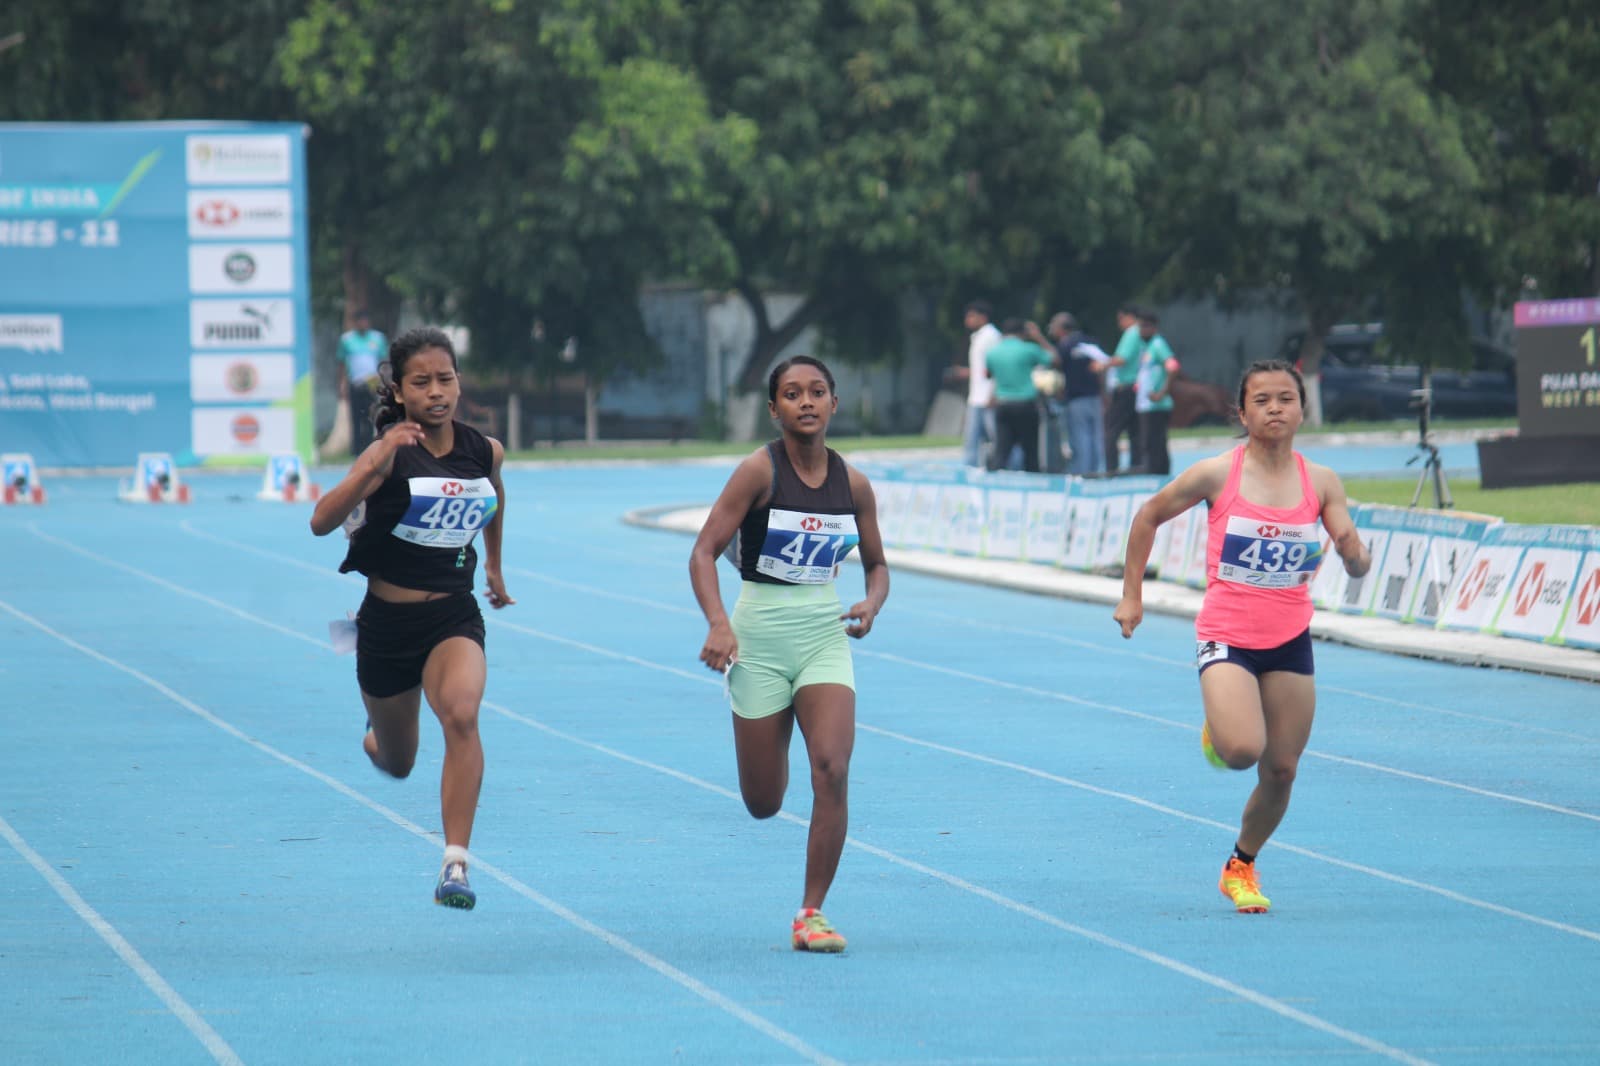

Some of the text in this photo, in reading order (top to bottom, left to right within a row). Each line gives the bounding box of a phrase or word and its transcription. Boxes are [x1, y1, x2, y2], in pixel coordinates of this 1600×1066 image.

[31, 187, 99, 207] INDIA
[80, 219, 119, 246] 11
[203, 322, 261, 340] PUMA
[1542, 390, 1580, 408] WEST
[419, 498, 485, 530] 486
[824, 521, 843, 530] HSBC
[1282, 529, 1303, 538] HSBC
[780, 533, 845, 566] 471
[1238, 539, 1307, 573] 439
